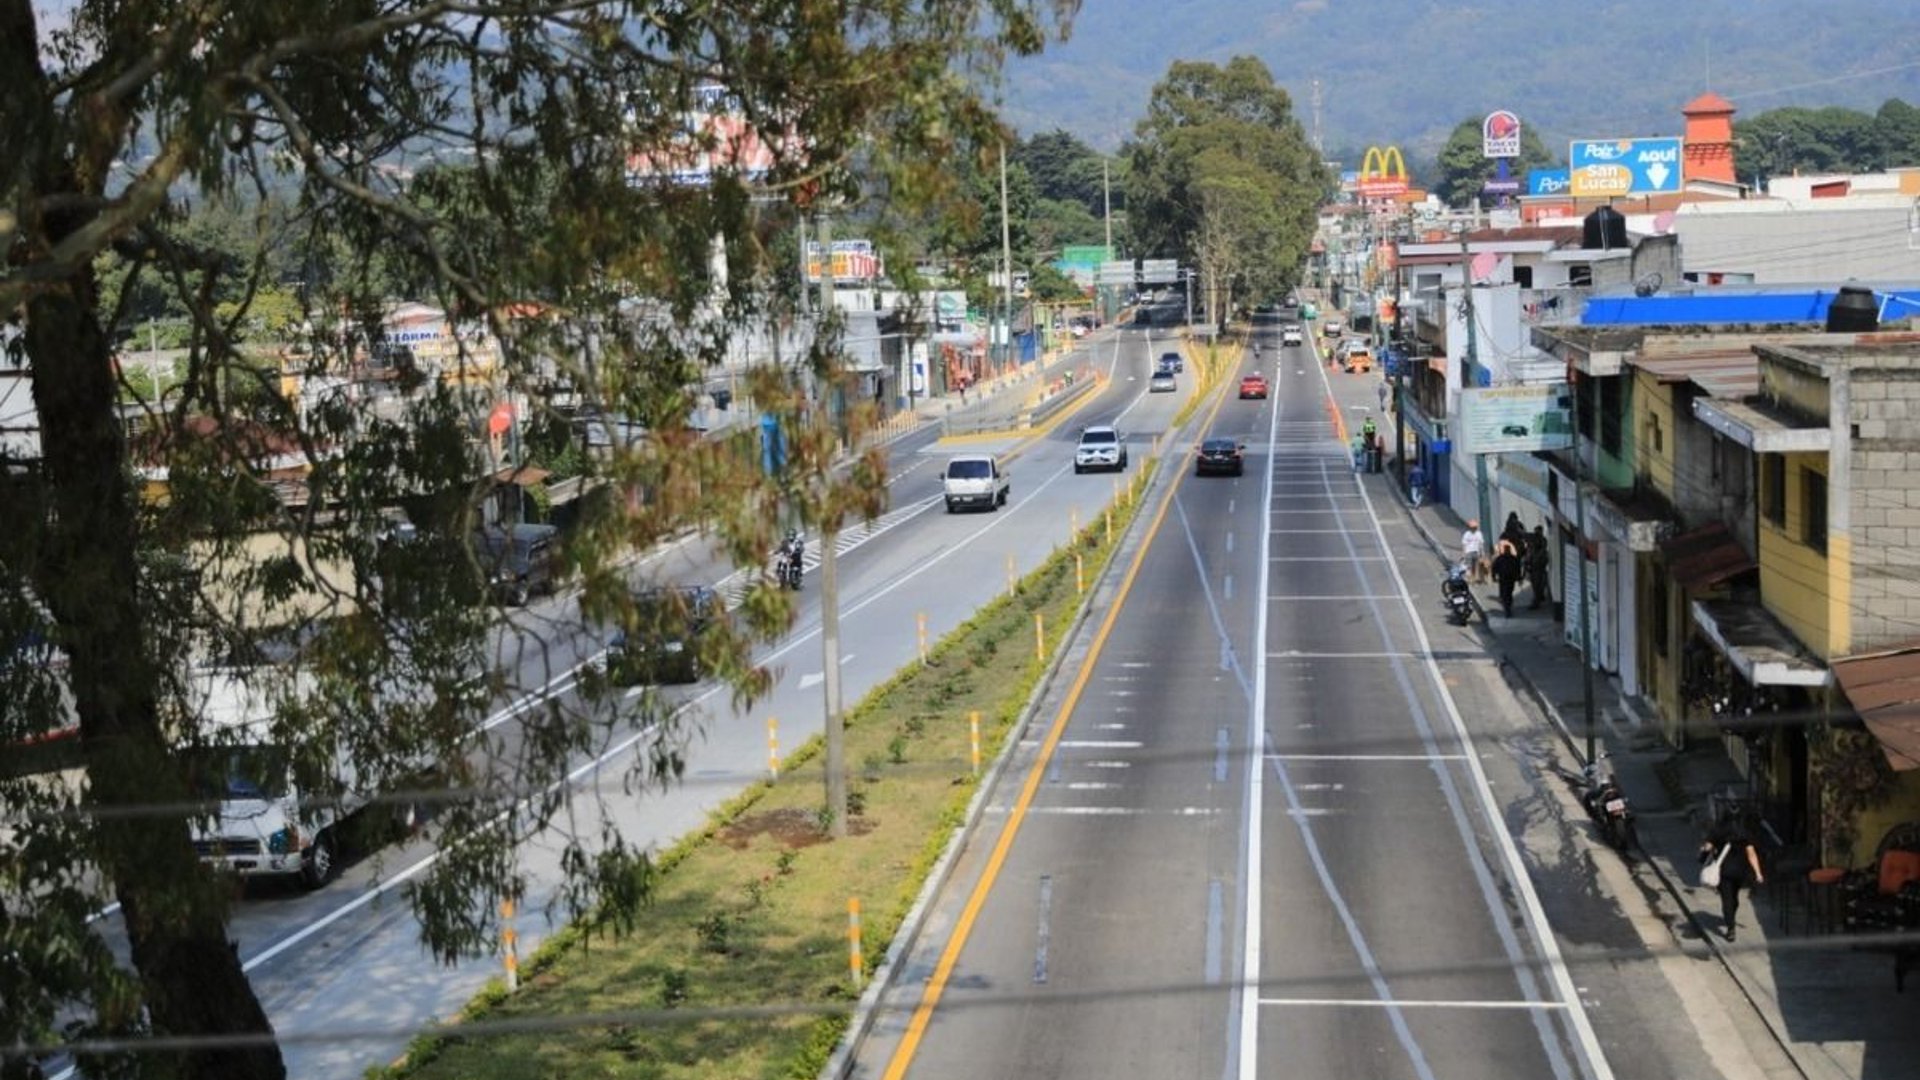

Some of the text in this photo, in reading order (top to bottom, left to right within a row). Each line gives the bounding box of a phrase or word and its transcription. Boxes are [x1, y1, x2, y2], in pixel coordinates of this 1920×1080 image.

[1638, 147, 1677, 162] AQUÍ
[1587, 165, 1618, 177] San
[1578, 177, 1628, 189] Lucas
